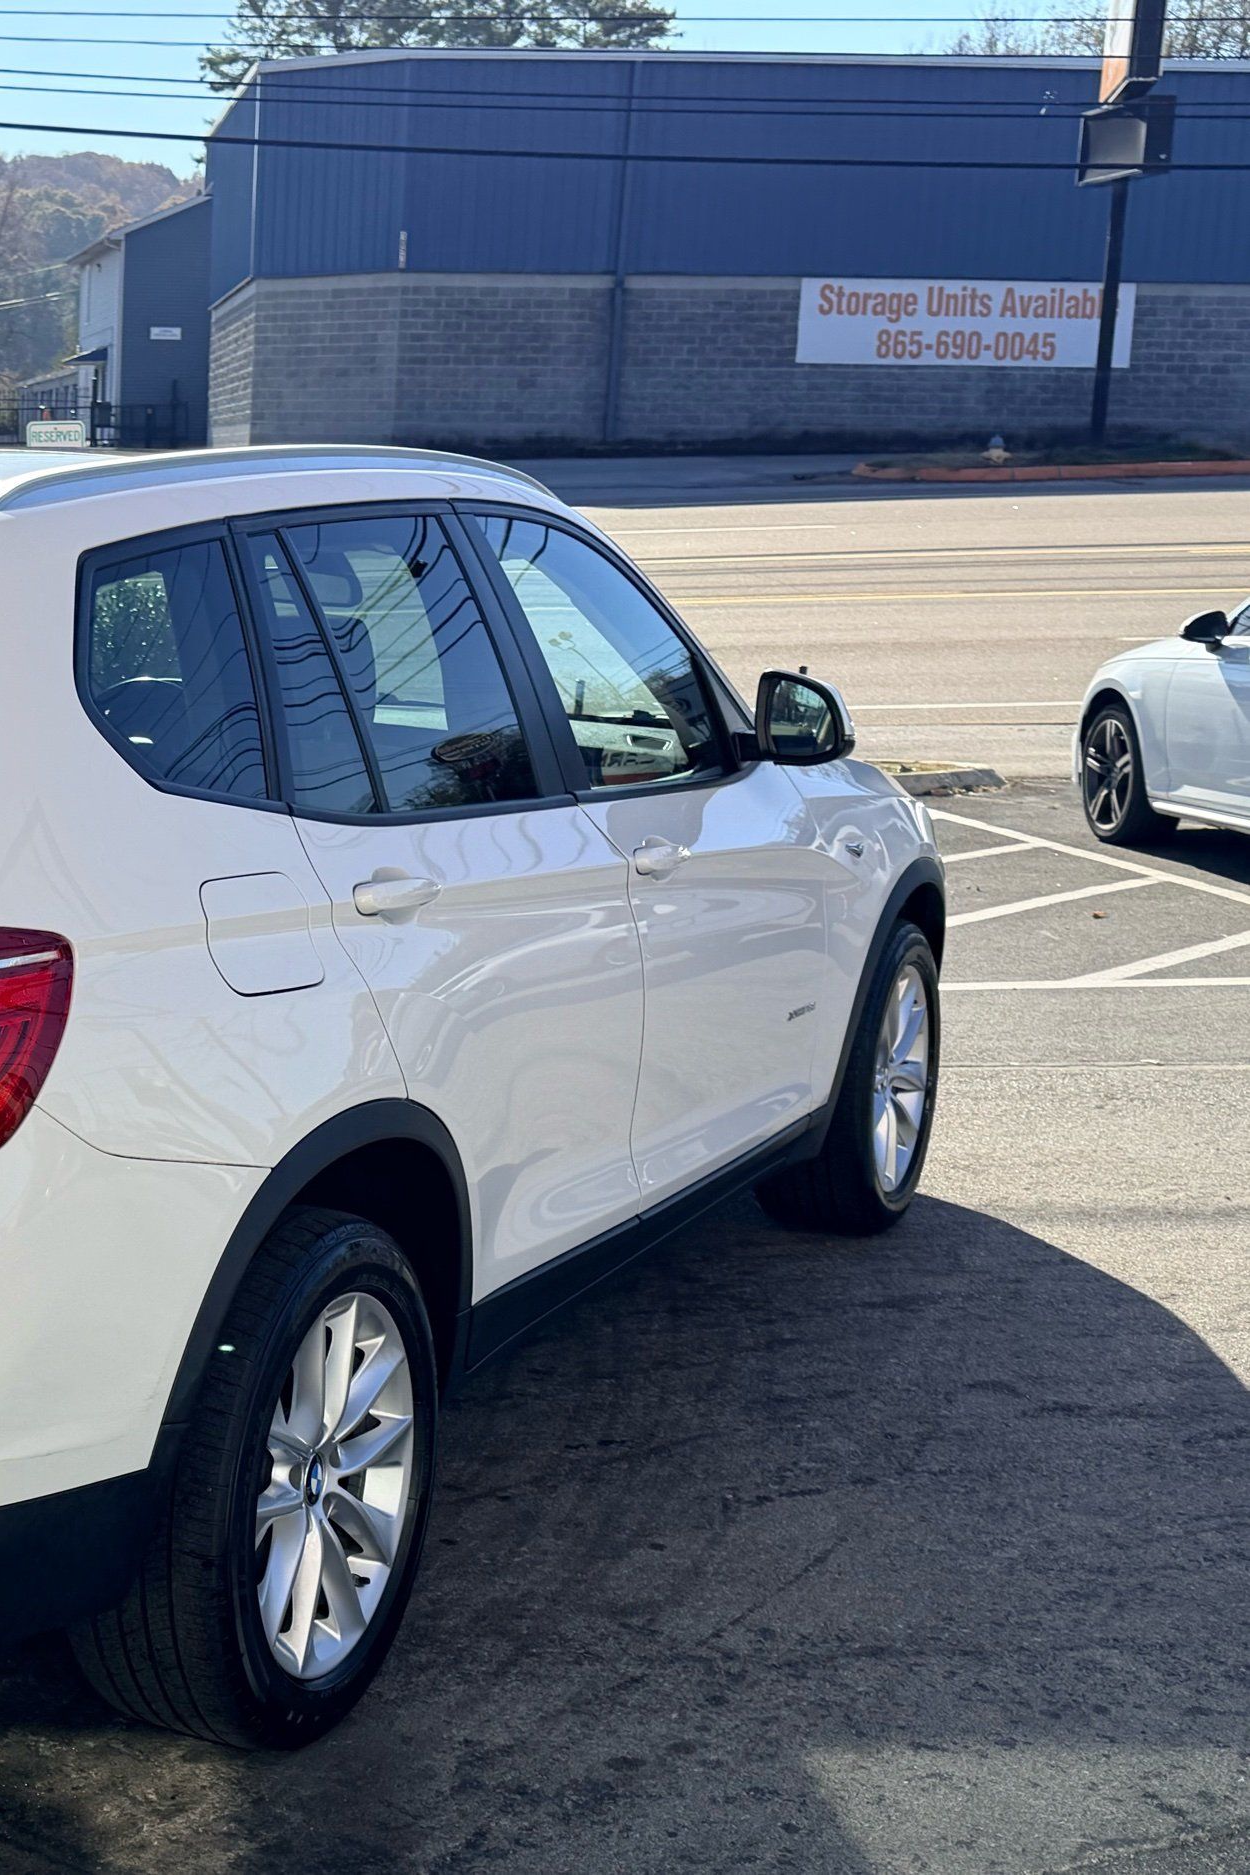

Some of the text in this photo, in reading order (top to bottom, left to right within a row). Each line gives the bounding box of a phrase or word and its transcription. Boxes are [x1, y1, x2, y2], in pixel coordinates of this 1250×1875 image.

[818, 283, 1105, 323] Storage Units Availabl
[875, 328, 1057, 362] 865-690-0045
[31, 430, 81, 443] RESERVED
